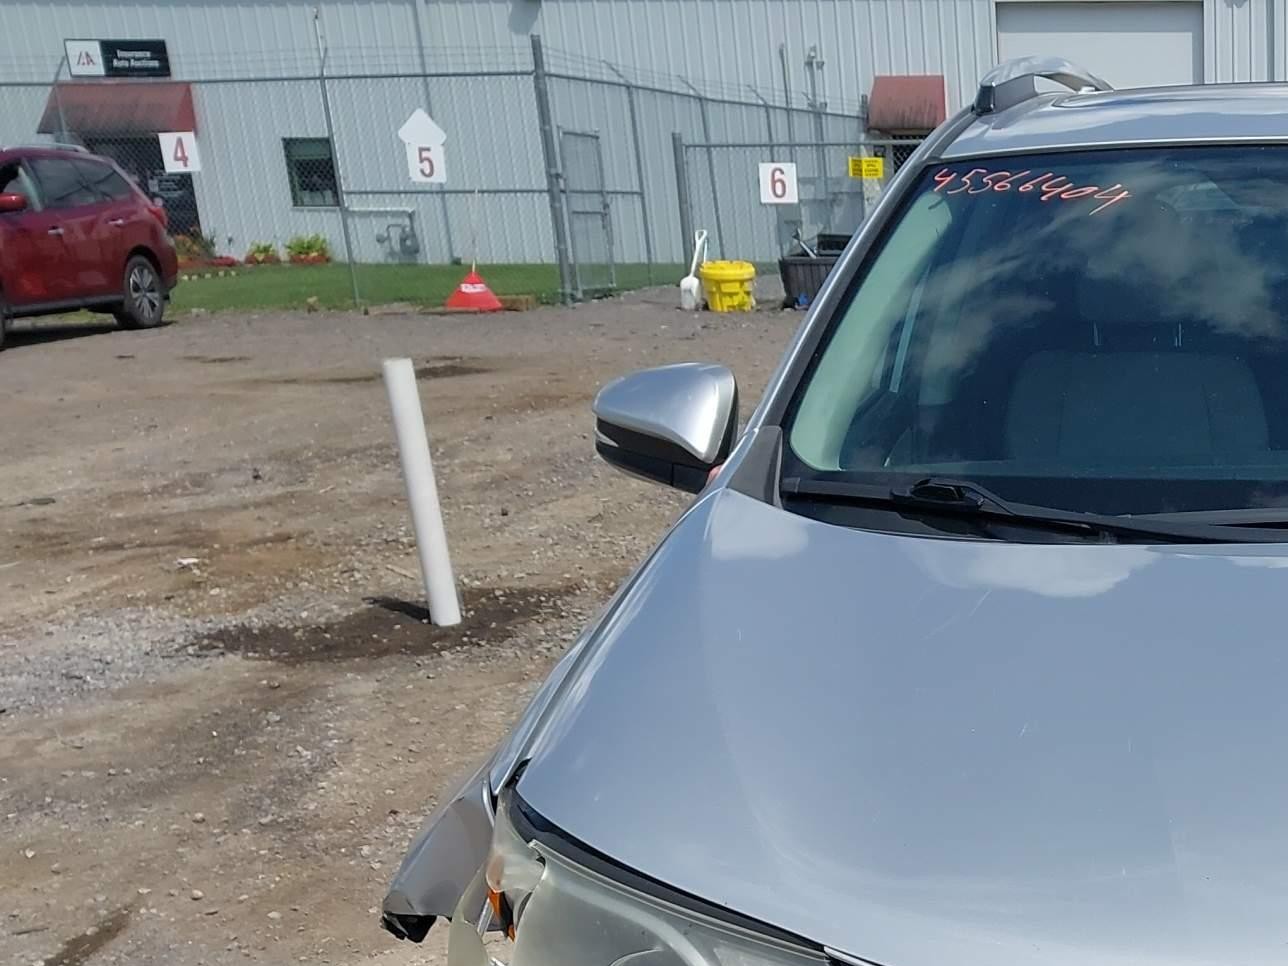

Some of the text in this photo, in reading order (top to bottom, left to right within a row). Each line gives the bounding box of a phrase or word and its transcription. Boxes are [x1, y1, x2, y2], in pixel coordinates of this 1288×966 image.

[174, 136, 188, 167] 4
[418, 146, 434, 178] 5
[771, 167, 786, 198] 6
[933, 168, 1132, 216] 45566404
